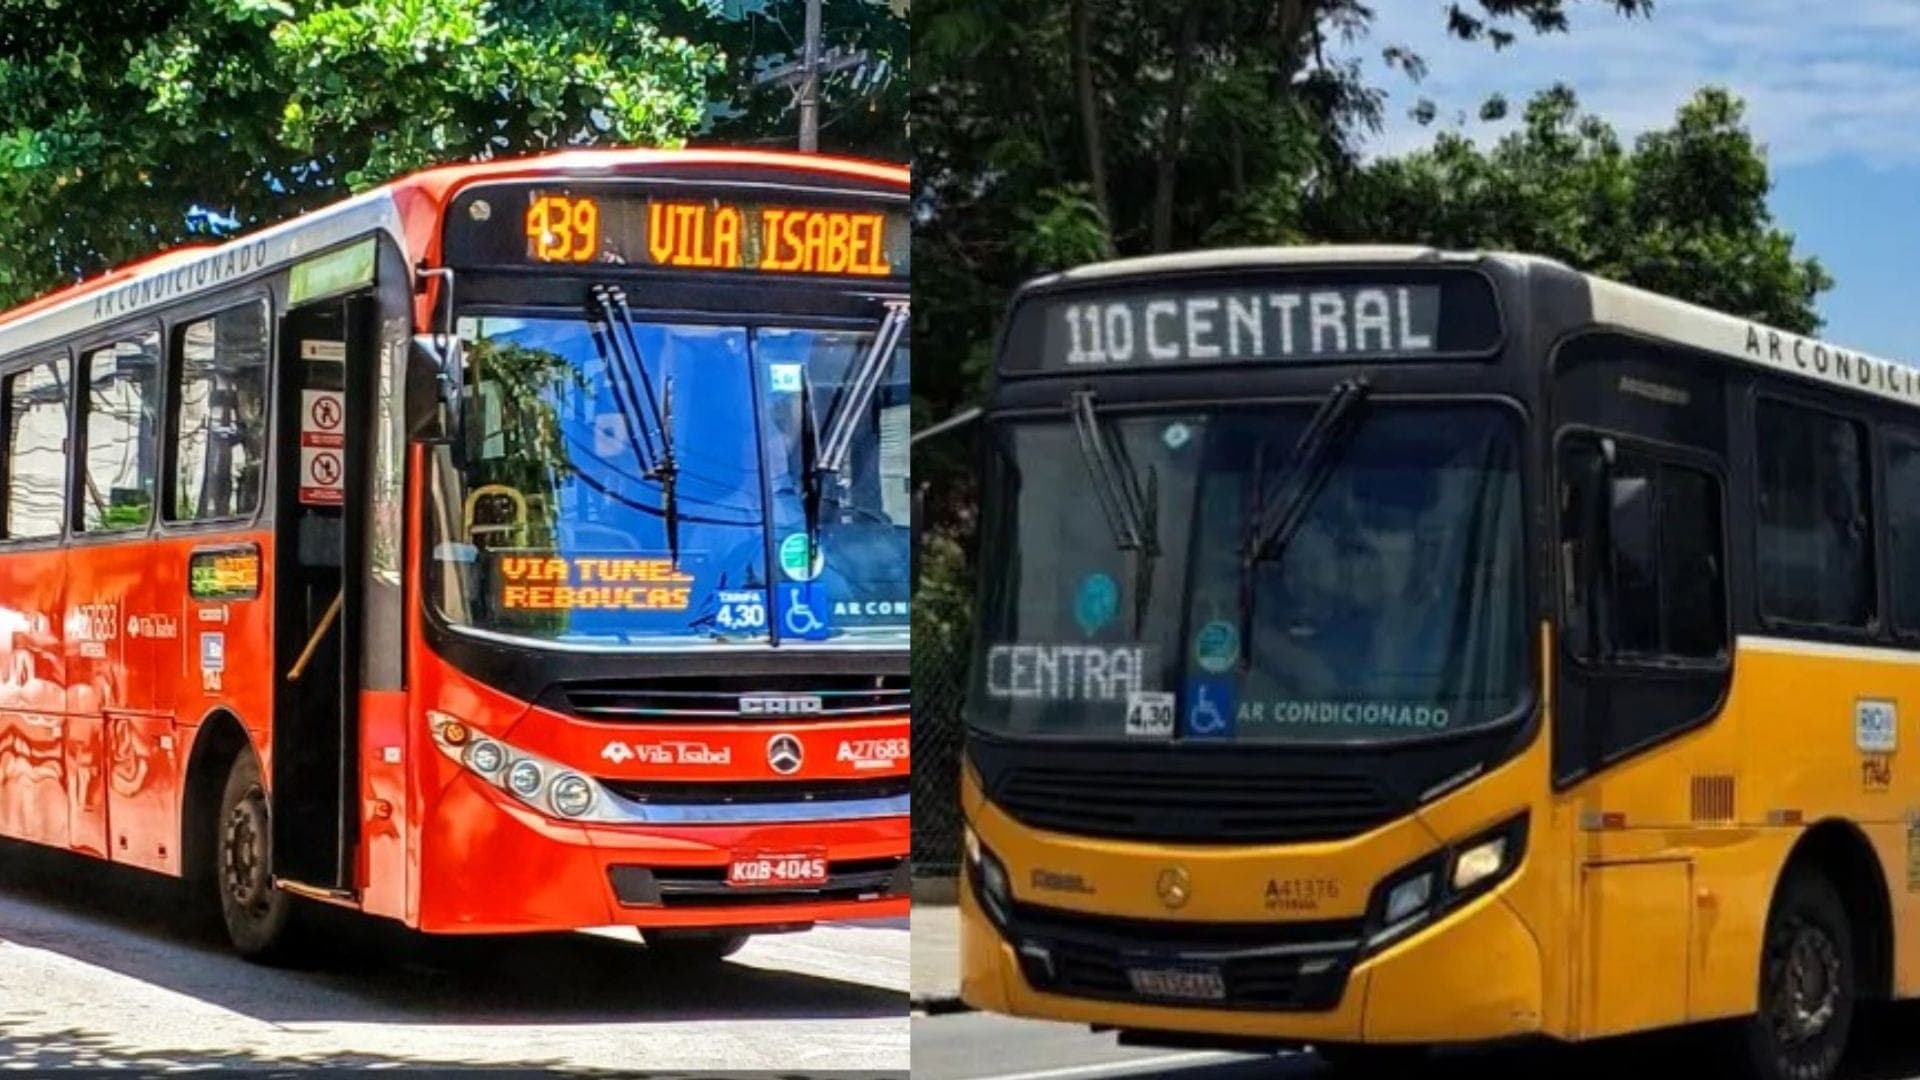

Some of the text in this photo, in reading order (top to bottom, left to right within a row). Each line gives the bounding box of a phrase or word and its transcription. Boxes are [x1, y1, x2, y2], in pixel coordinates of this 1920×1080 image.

[526, 195, 891, 276] 439 VILA ISABEL
[94, 239, 267, 320] AR CONDICIONADO
[1065, 287, 1432, 364] 110 CENTRAL
[1745, 325, 1920, 397] AR CONDICI
[502, 558, 569, 580] VIA
[503, 586, 692, 609] REBOUCAS
[834, 602, 862, 615] AR
[716, 604, 765, 630] 4,30
[1129, 704, 1171, 728] 4,30
[1236, 701, 1449, 728] AR CONDICIONADO
[636, 743, 731, 765] Vila Isabel
[836, 738, 910, 762] A27683
